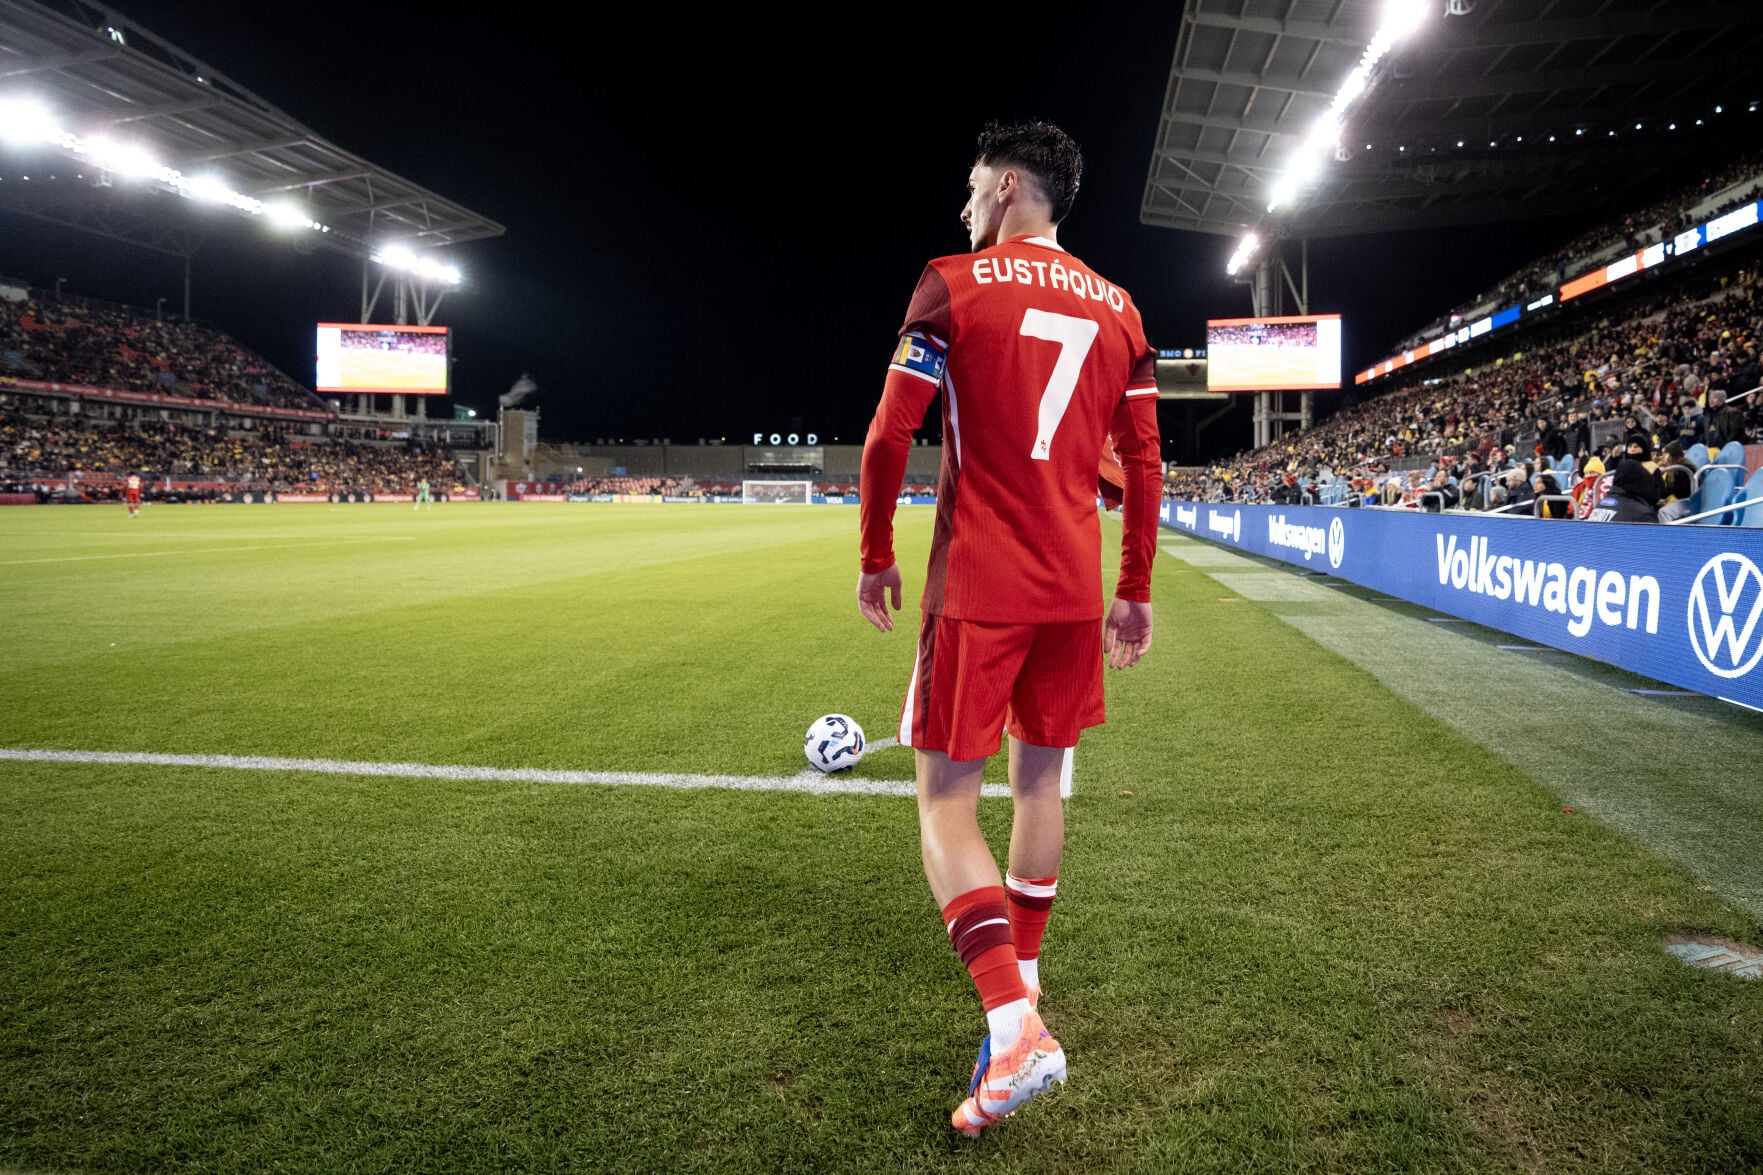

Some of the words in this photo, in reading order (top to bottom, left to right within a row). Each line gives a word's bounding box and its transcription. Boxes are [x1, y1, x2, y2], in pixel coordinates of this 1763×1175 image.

[972, 257, 1124, 313] EUSTÁQUIO
[1019, 307, 1099, 461] 7
[753, 432, 819, 446] FOOD
[1268, 514, 1326, 560] Volkswagen
[1436, 533, 1660, 637] Volkswagen
